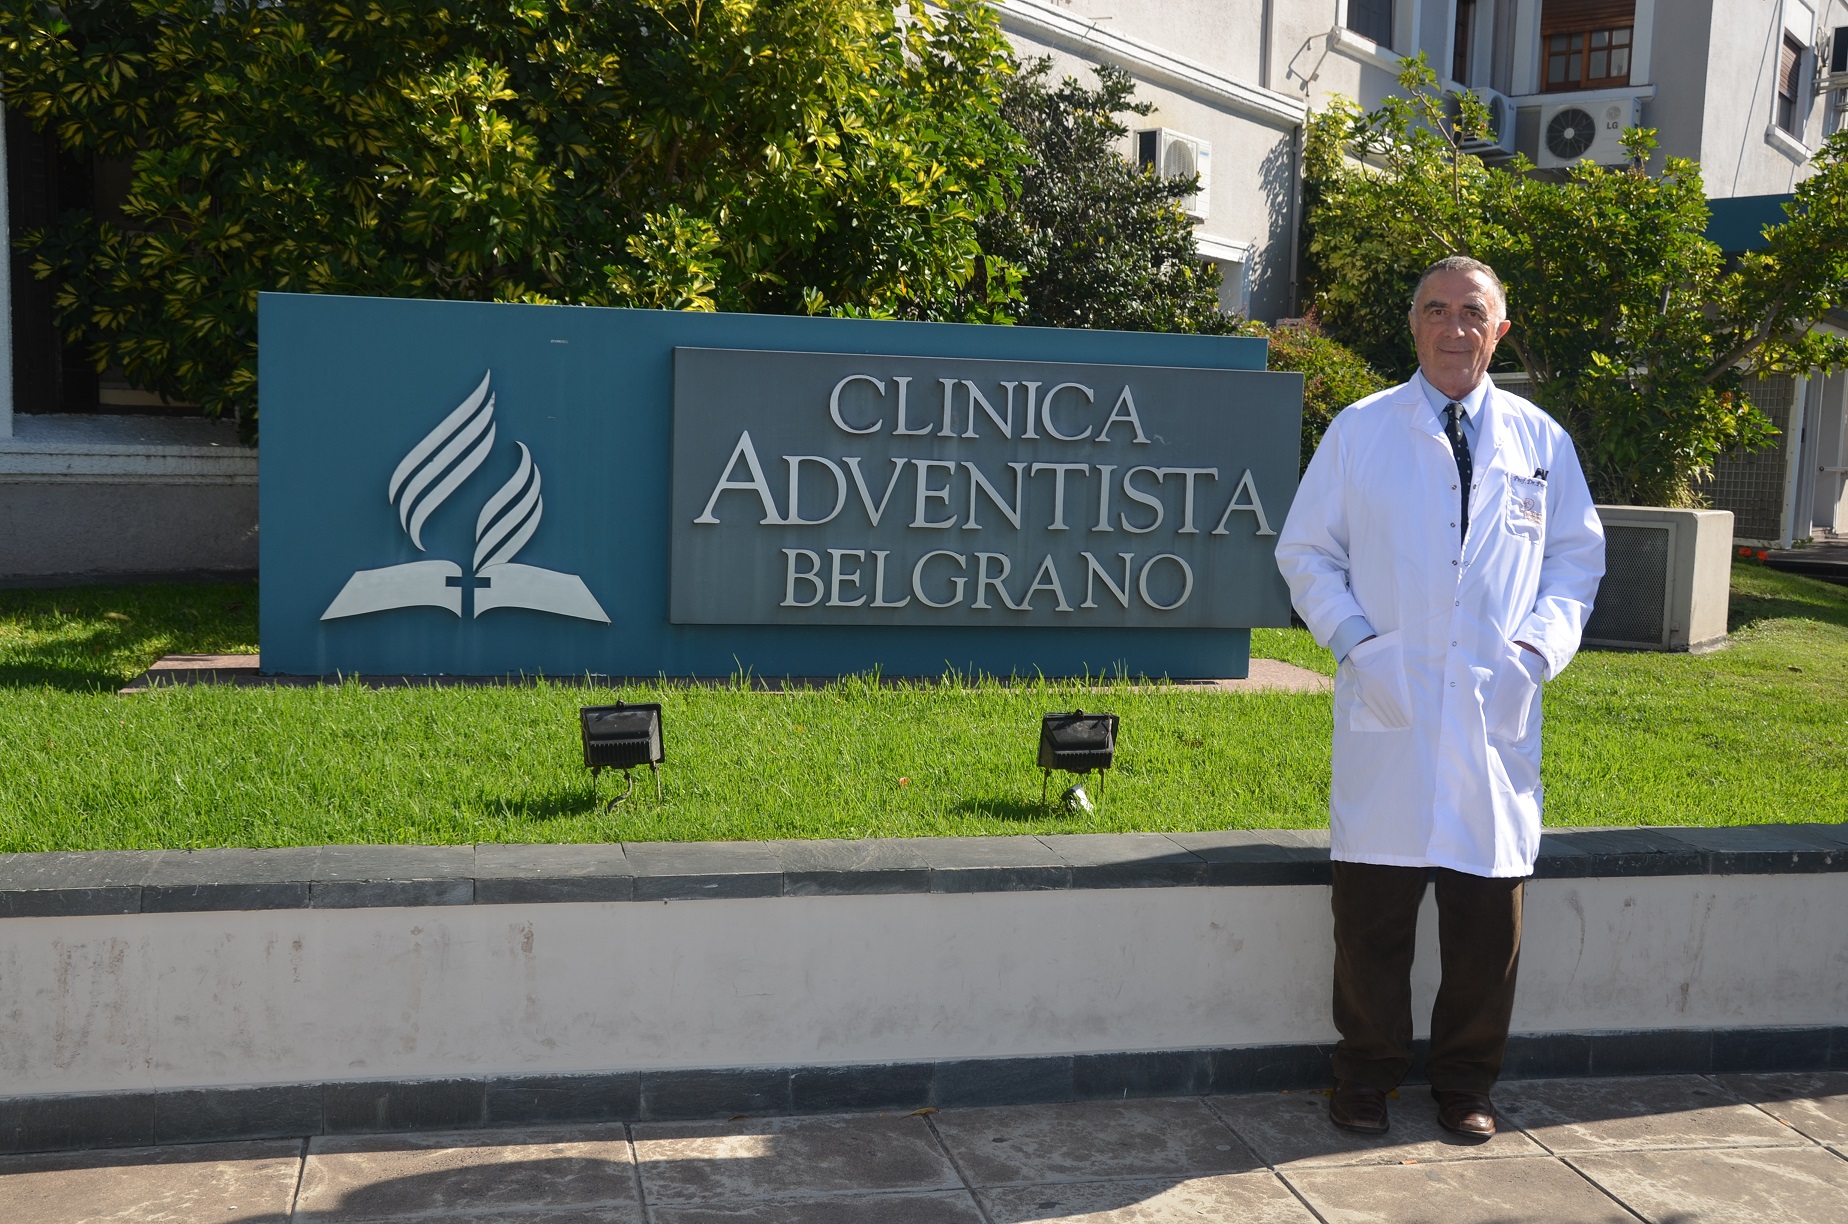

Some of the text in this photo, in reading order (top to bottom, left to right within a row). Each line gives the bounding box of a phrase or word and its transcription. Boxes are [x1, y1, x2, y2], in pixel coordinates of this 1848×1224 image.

[1606, 121, 1619, 130] LG
[829, 374, 1150, 444] CLINICA
[693, 430, 1277, 537] ADVENTISTA
[779, 548, 1195, 612] BELGRANO
